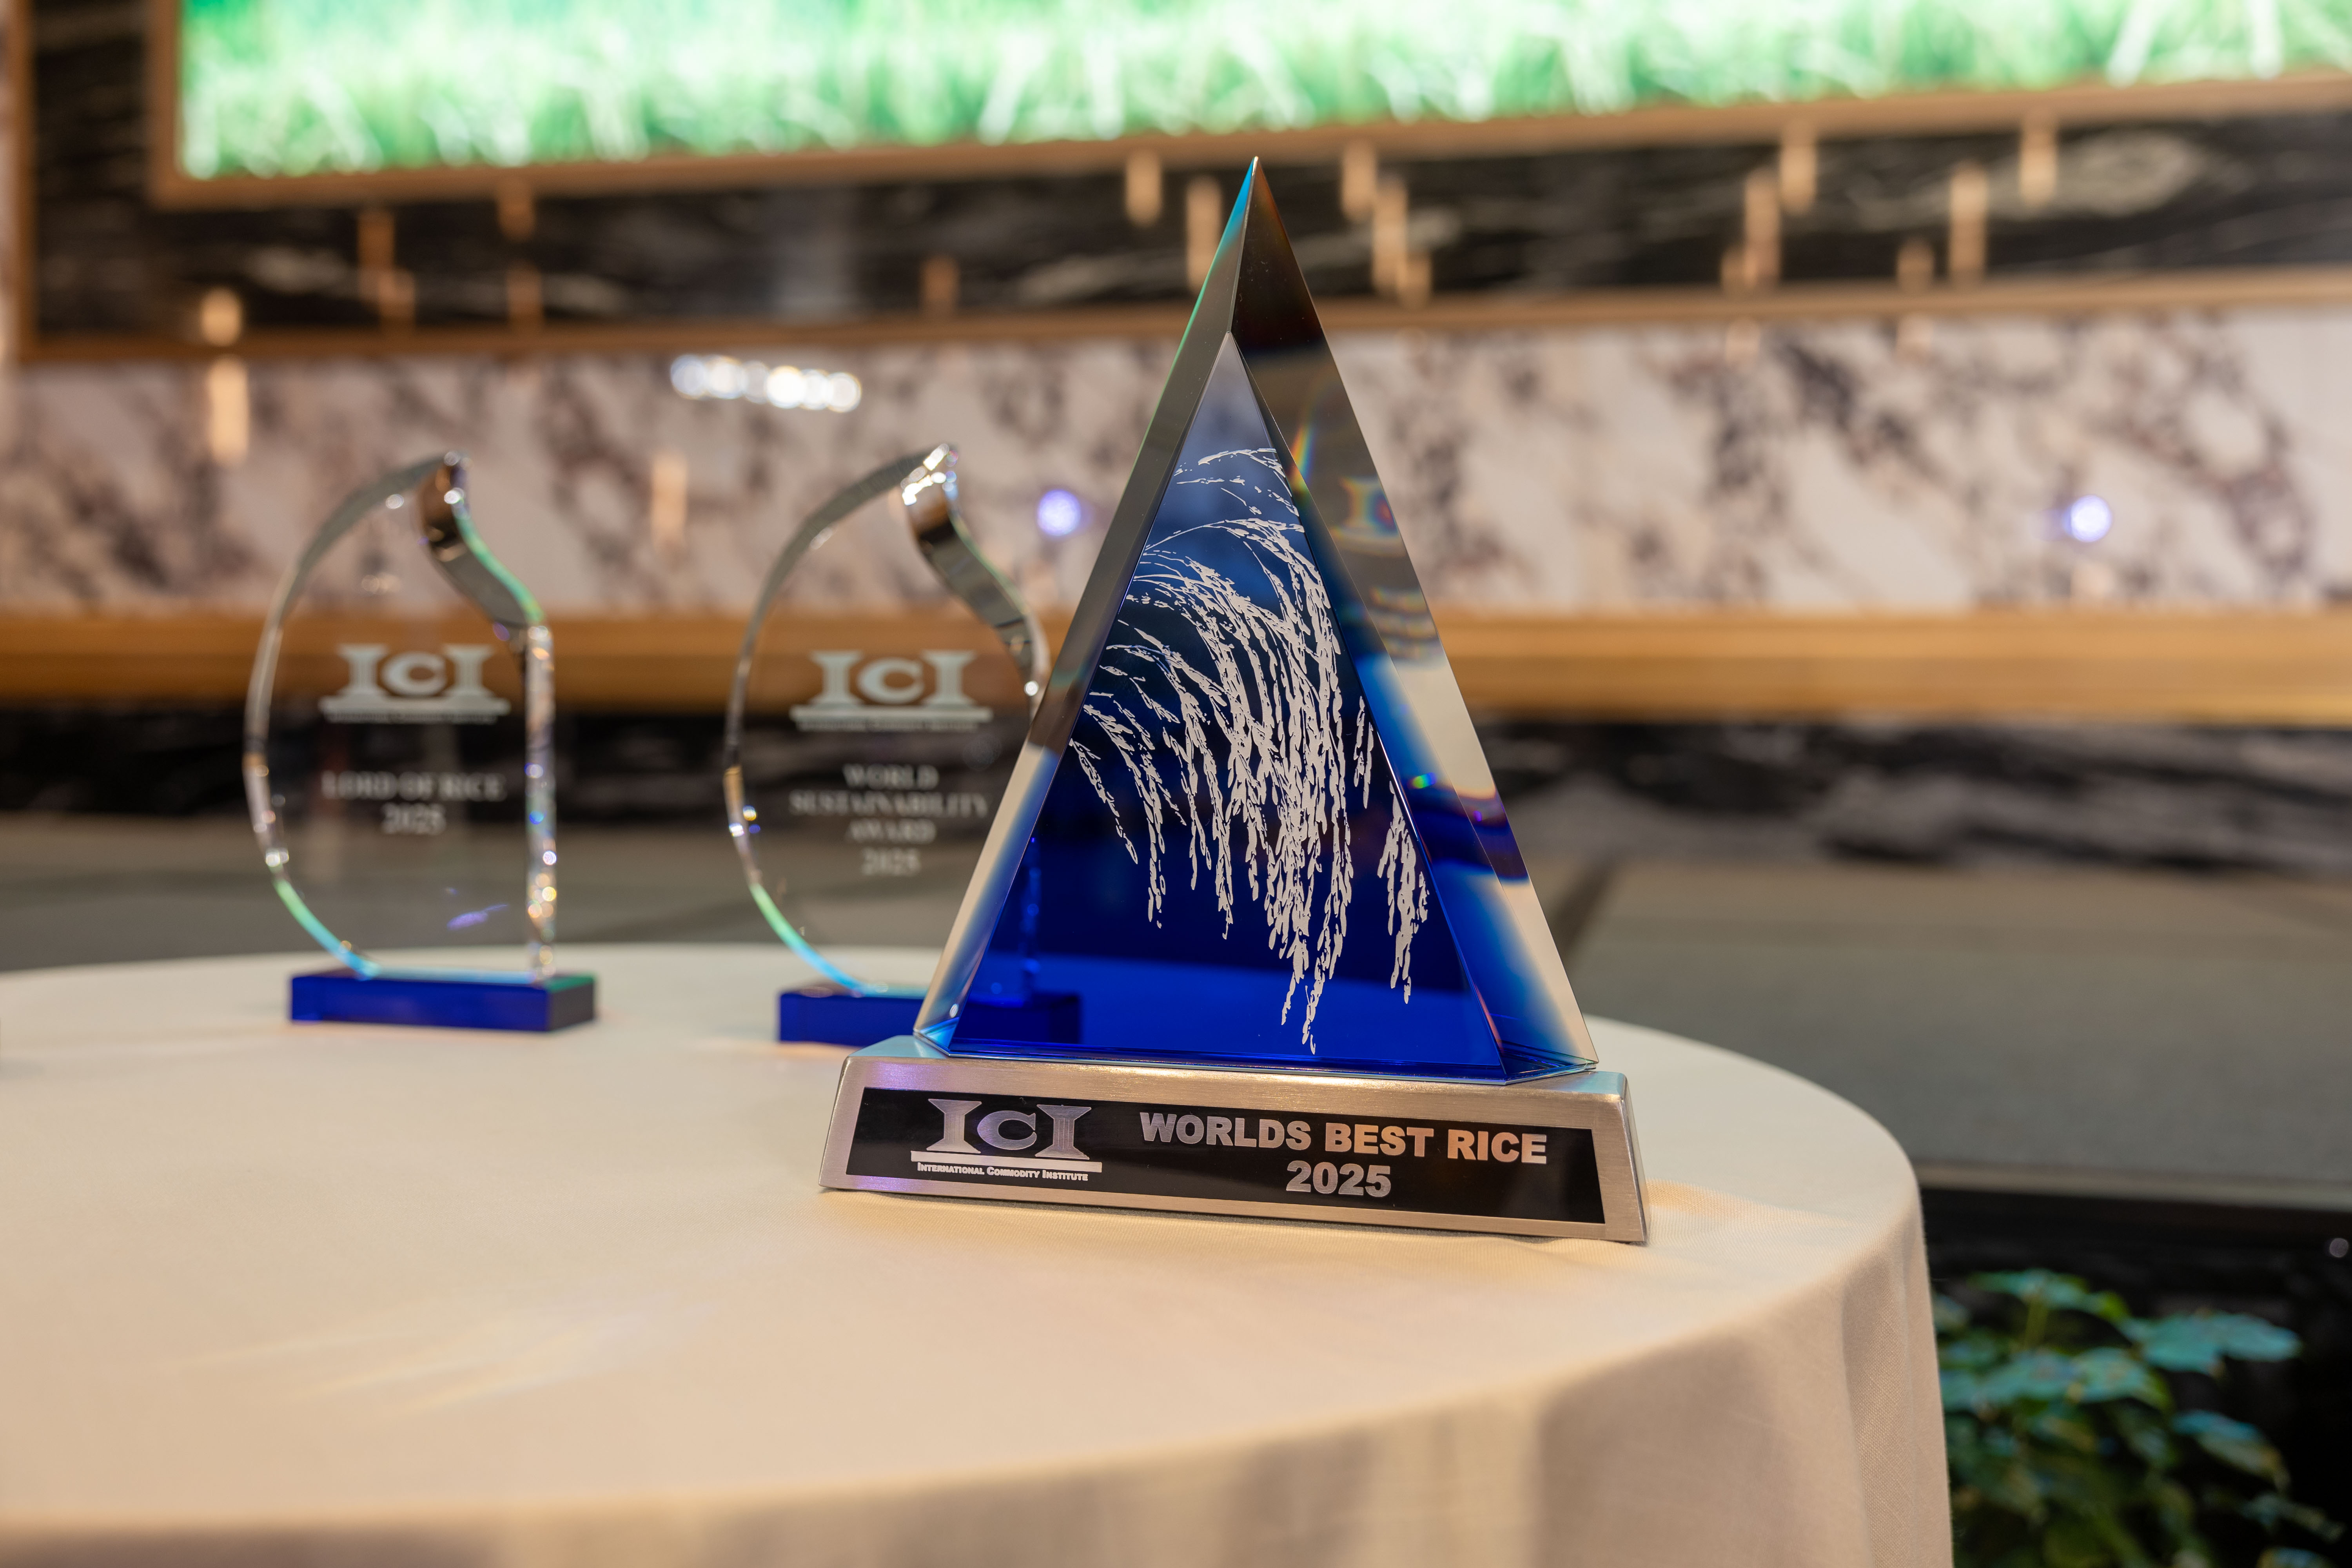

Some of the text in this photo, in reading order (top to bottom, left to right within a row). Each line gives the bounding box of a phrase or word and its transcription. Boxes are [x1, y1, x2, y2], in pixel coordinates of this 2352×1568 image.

[1140, 1112, 1547, 1164] WORLDS BEST RICE
[1286, 1161, 1391, 1197] 2025
